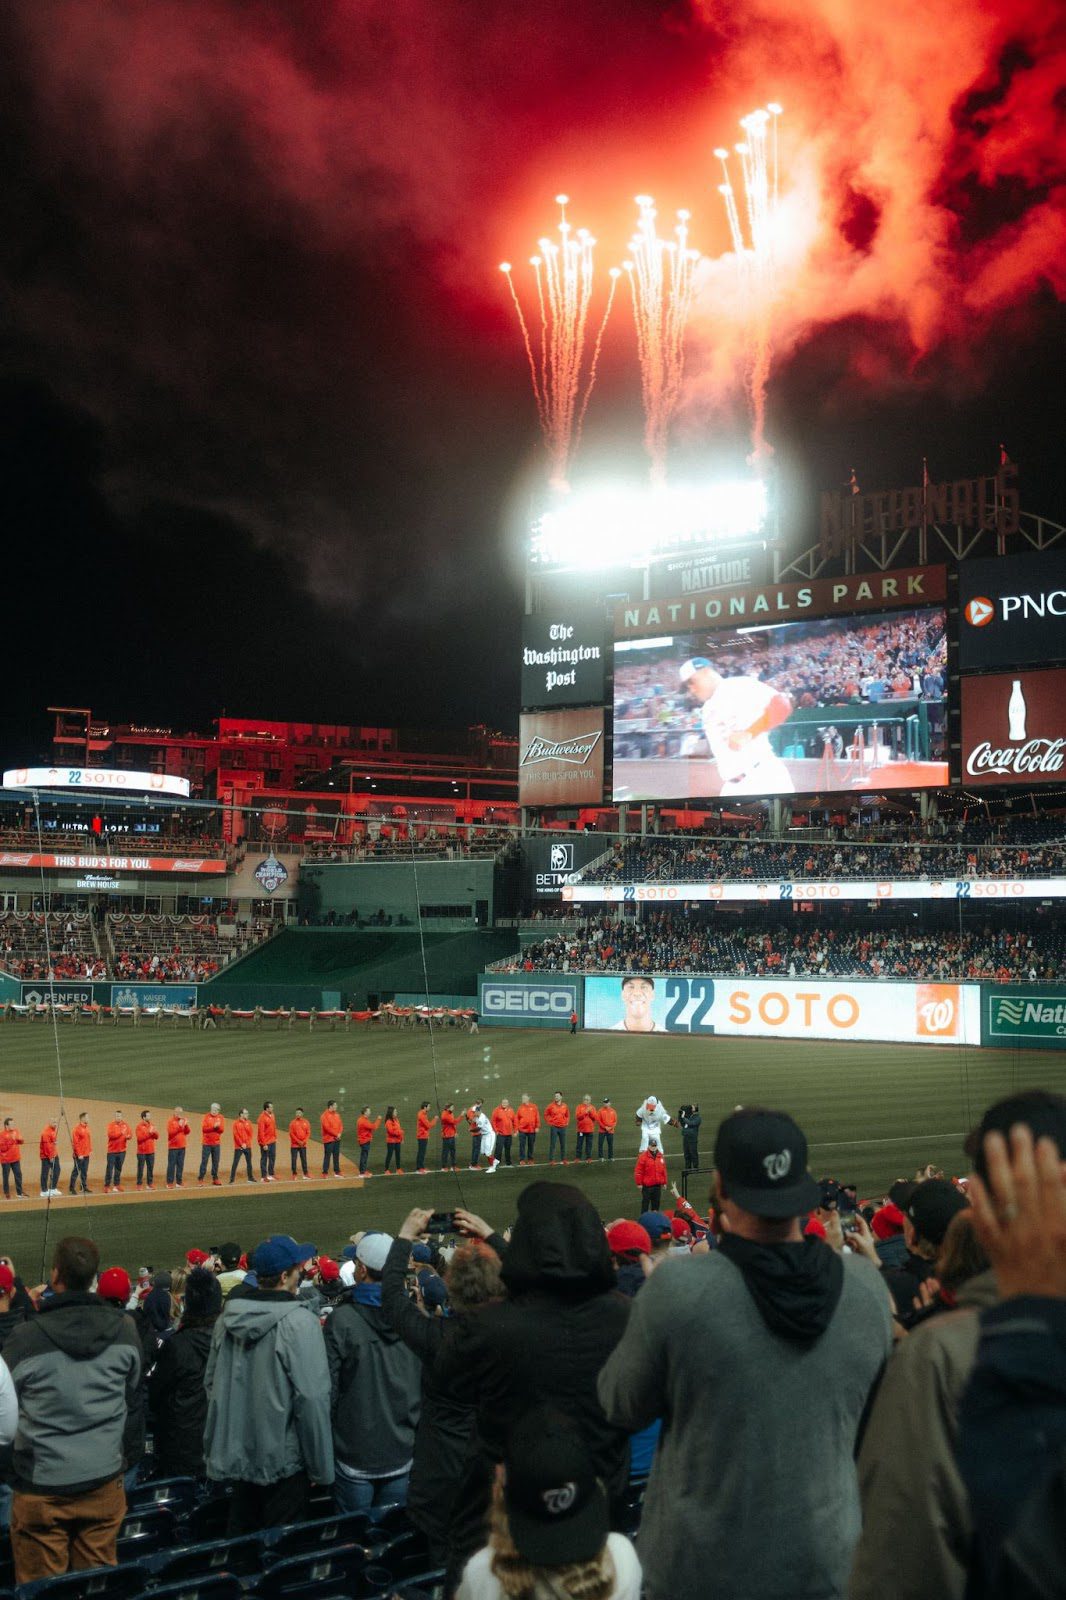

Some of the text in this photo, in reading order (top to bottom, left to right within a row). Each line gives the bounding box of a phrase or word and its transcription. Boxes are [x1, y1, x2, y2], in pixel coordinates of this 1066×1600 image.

[681, 558, 751, 592] NATITUDE
[624, 574, 925, 627] NATIONALS PARK
[999, 591, 1066, 620] PNC
[549, 624, 574, 641] The
[523, 645, 600, 666] Washington
[545, 669, 576, 692] Post
[528, 742, 593, 757] Budweiser
[966, 738, 1066, 775] Coca-Cola
[69, 770, 126, 785] 22 SOTO
[62, 823, 89, 831] ULTRA
[54, 856, 152, 869] THIS BUD'S FOR YOU.
[76, 880, 120, 889] BREW HOUSE
[779, 884, 840, 899] 22 SOTO
[956, 882, 1025, 898] 22 SOTO
[623, 886, 679, 900] 22 SOTO
[44, 993, 89, 1002] PENFED
[143, 994, 167, 1002] KAISER
[484, 989, 573, 1012] GEICO
[665, 977, 860, 1033] 22 SOTO
